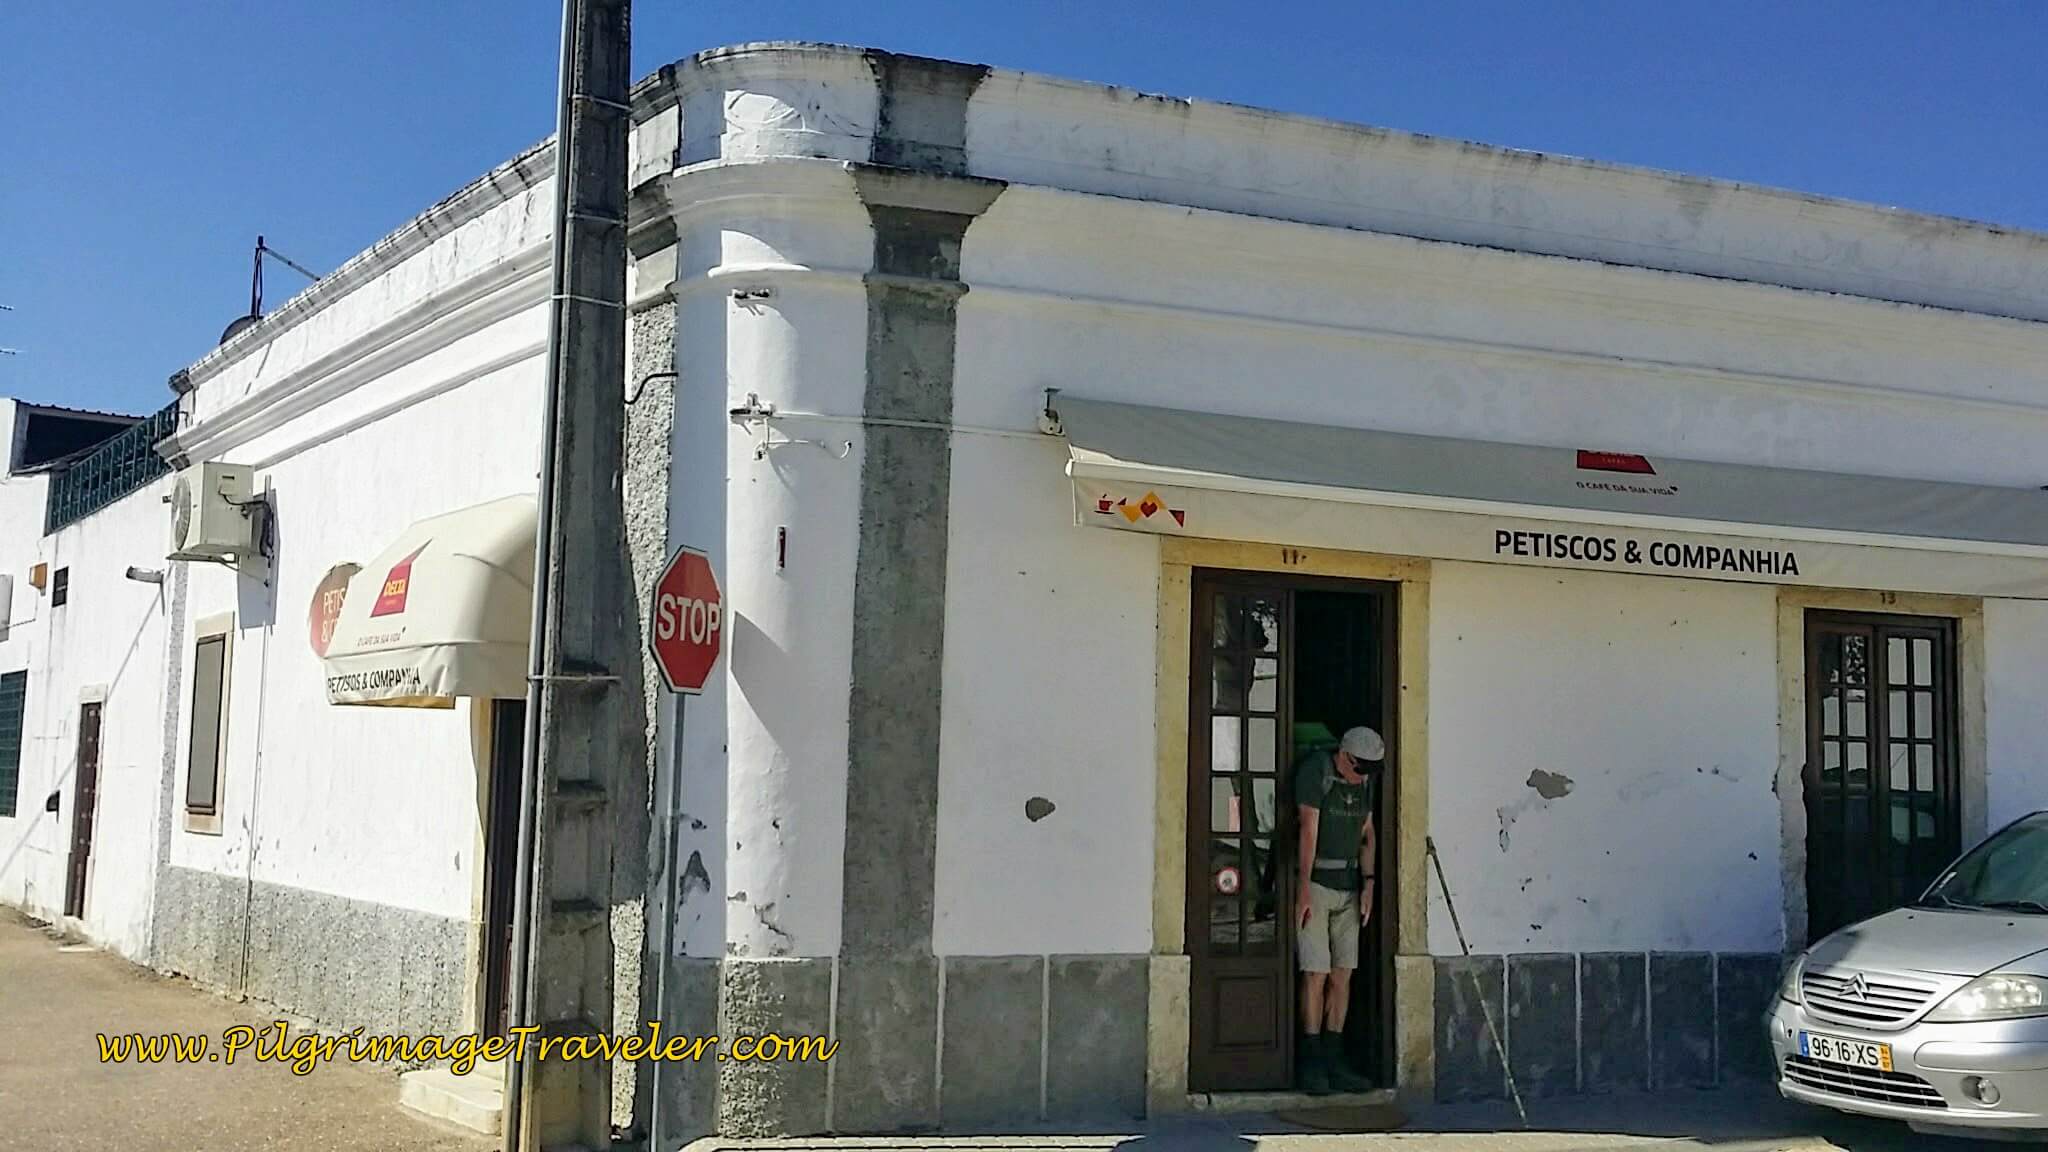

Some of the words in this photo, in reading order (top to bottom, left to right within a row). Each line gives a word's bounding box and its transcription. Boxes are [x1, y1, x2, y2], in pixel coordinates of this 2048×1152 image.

[1495, 529, 1616, 562] PETISCOS
[1624, 540, 1642, 564] &
[1650, 541, 1800, 576] COMPANHIA
[657, 593, 720, 645] STOP
[1879, 592, 1897, 605] 13
